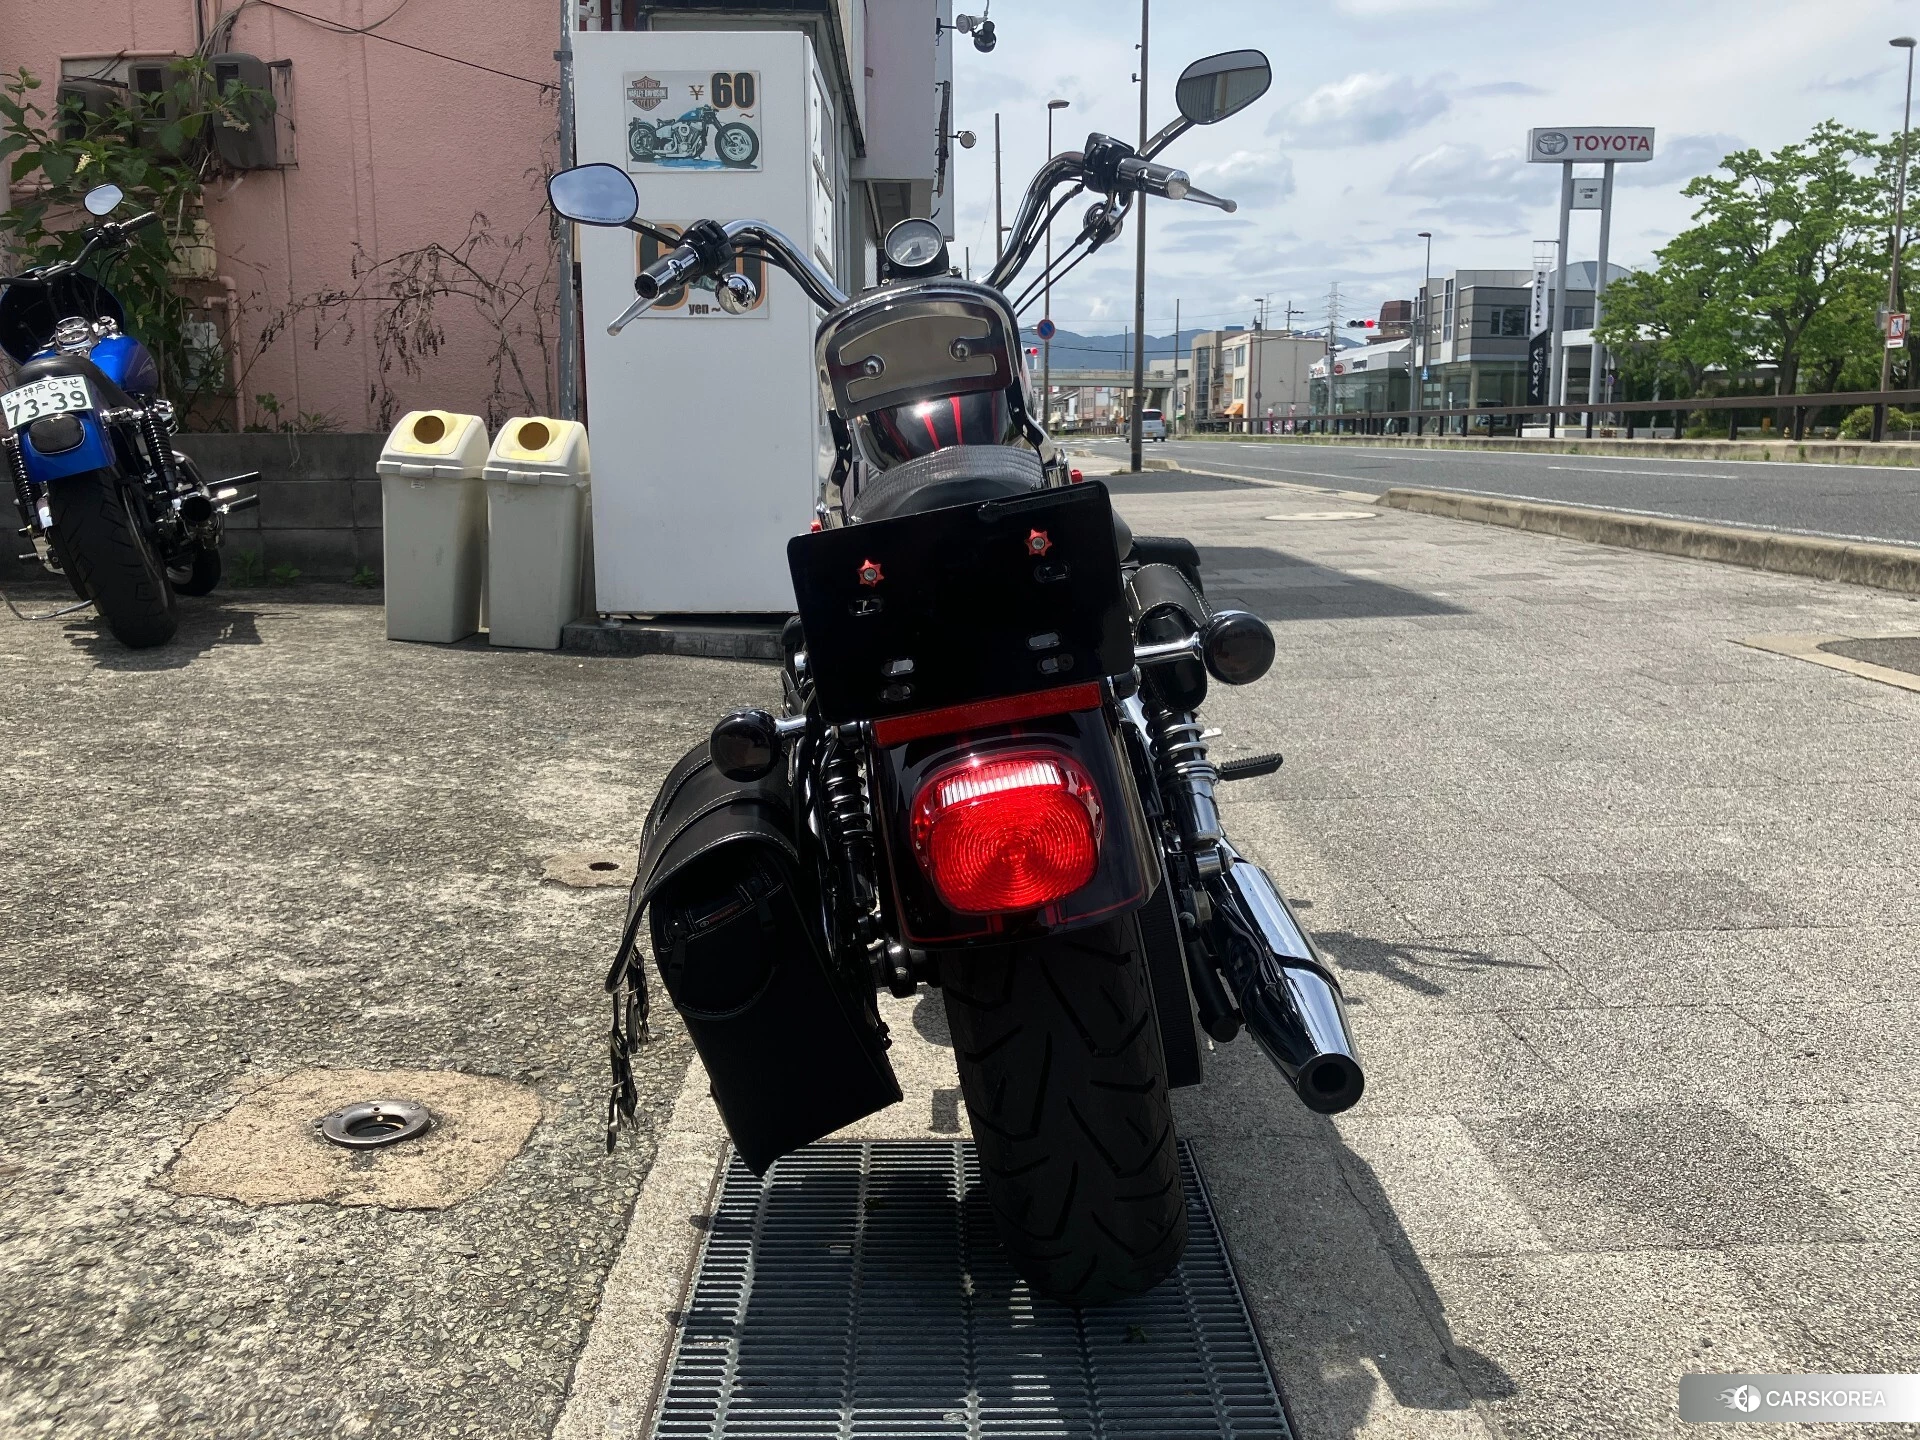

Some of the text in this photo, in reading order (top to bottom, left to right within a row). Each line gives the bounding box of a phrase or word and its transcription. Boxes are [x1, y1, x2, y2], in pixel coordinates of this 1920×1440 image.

[711, 72, 755, 109] 60
[1572, 135, 1650, 151] TOYOTA
[688, 303, 709, 315] yen
[1532, 348, 1540, 398] VOXY
[7, 390, 87, 425] 73-39
